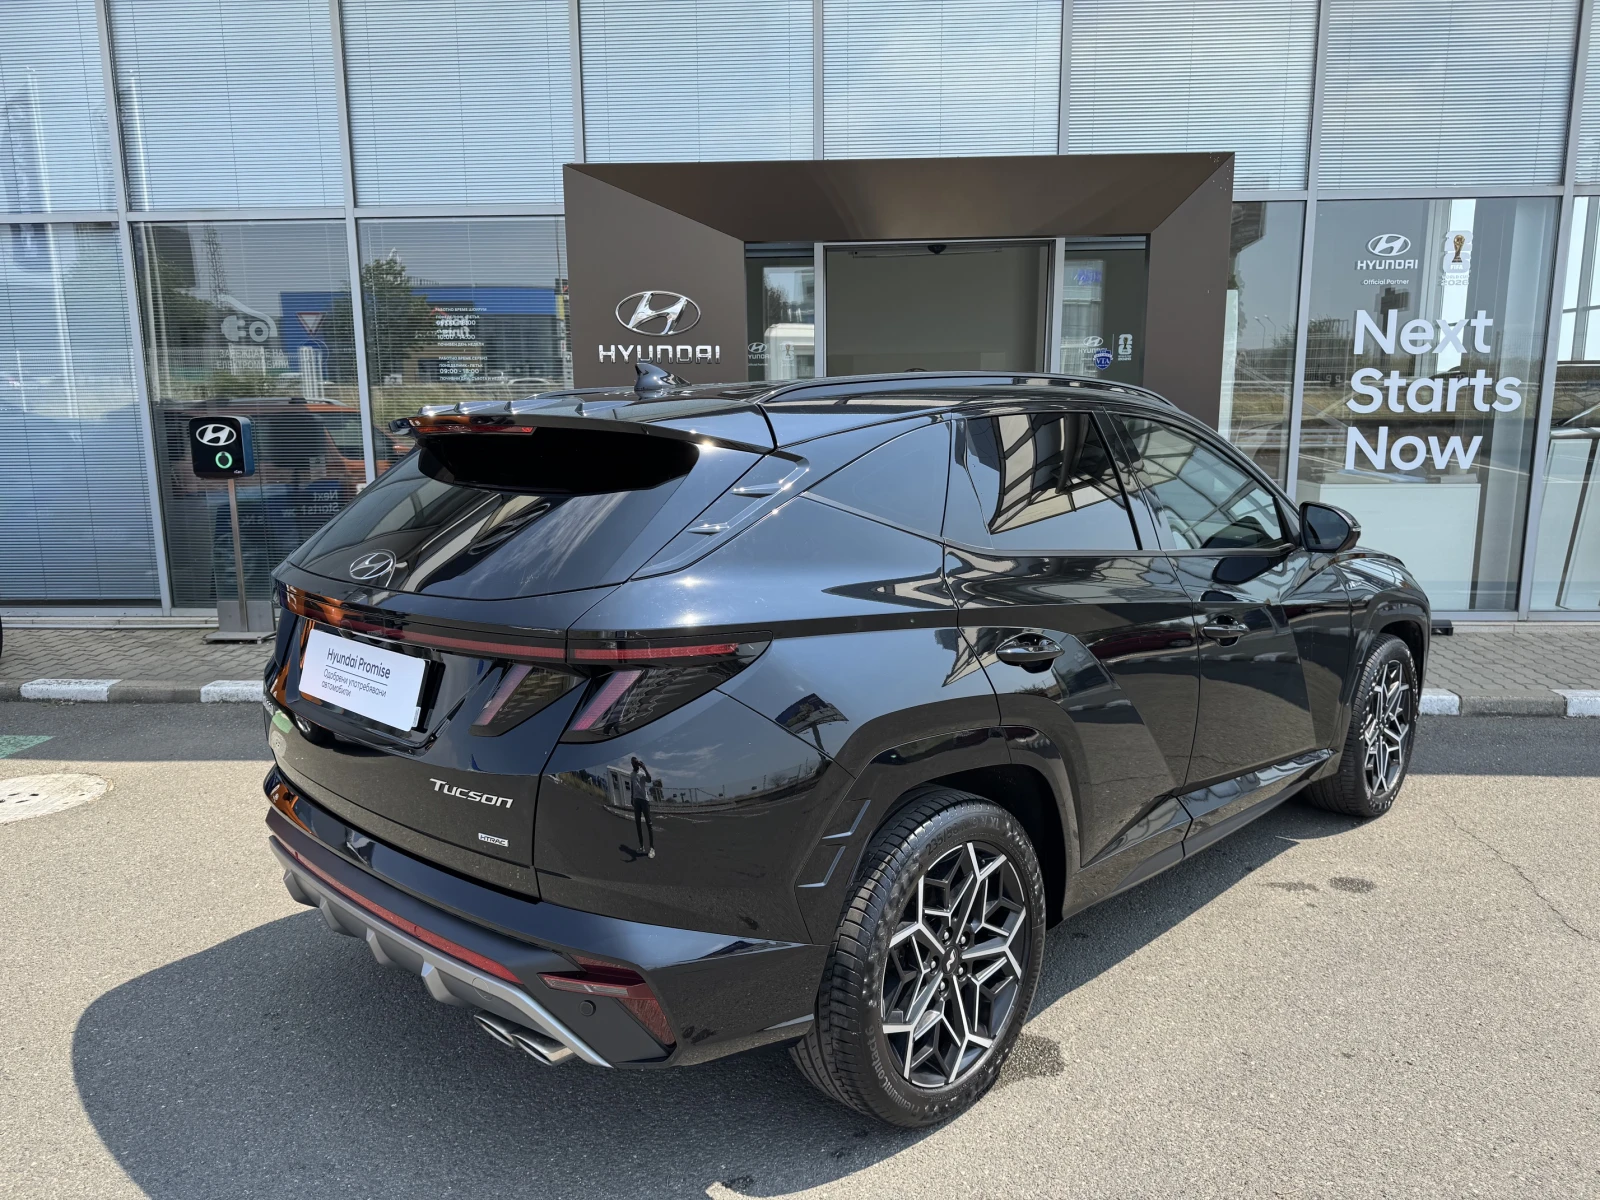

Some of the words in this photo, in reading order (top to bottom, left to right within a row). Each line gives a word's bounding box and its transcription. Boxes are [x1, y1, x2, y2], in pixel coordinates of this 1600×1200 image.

[1357, 259, 1418, 270] HYUNDAI
[1353, 309, 1493, 355] Next
[598, 344, 721, 364] HYUNDAI
[1346, 367, 1521, 414] Starts
[1344, 426, 1483, 471] Now
[326, 648, 358, 670] Hyundai
[357, 657, 391, 679] Promise
[321, 680, 352, 697] автомобили
[323, 668, 348, 684] Одобрени
[348, 678, 387, 698] употребявани
[480, 834, 506, 846] HTRAC
[867, 1040, 920, 1113] PremiumContact
